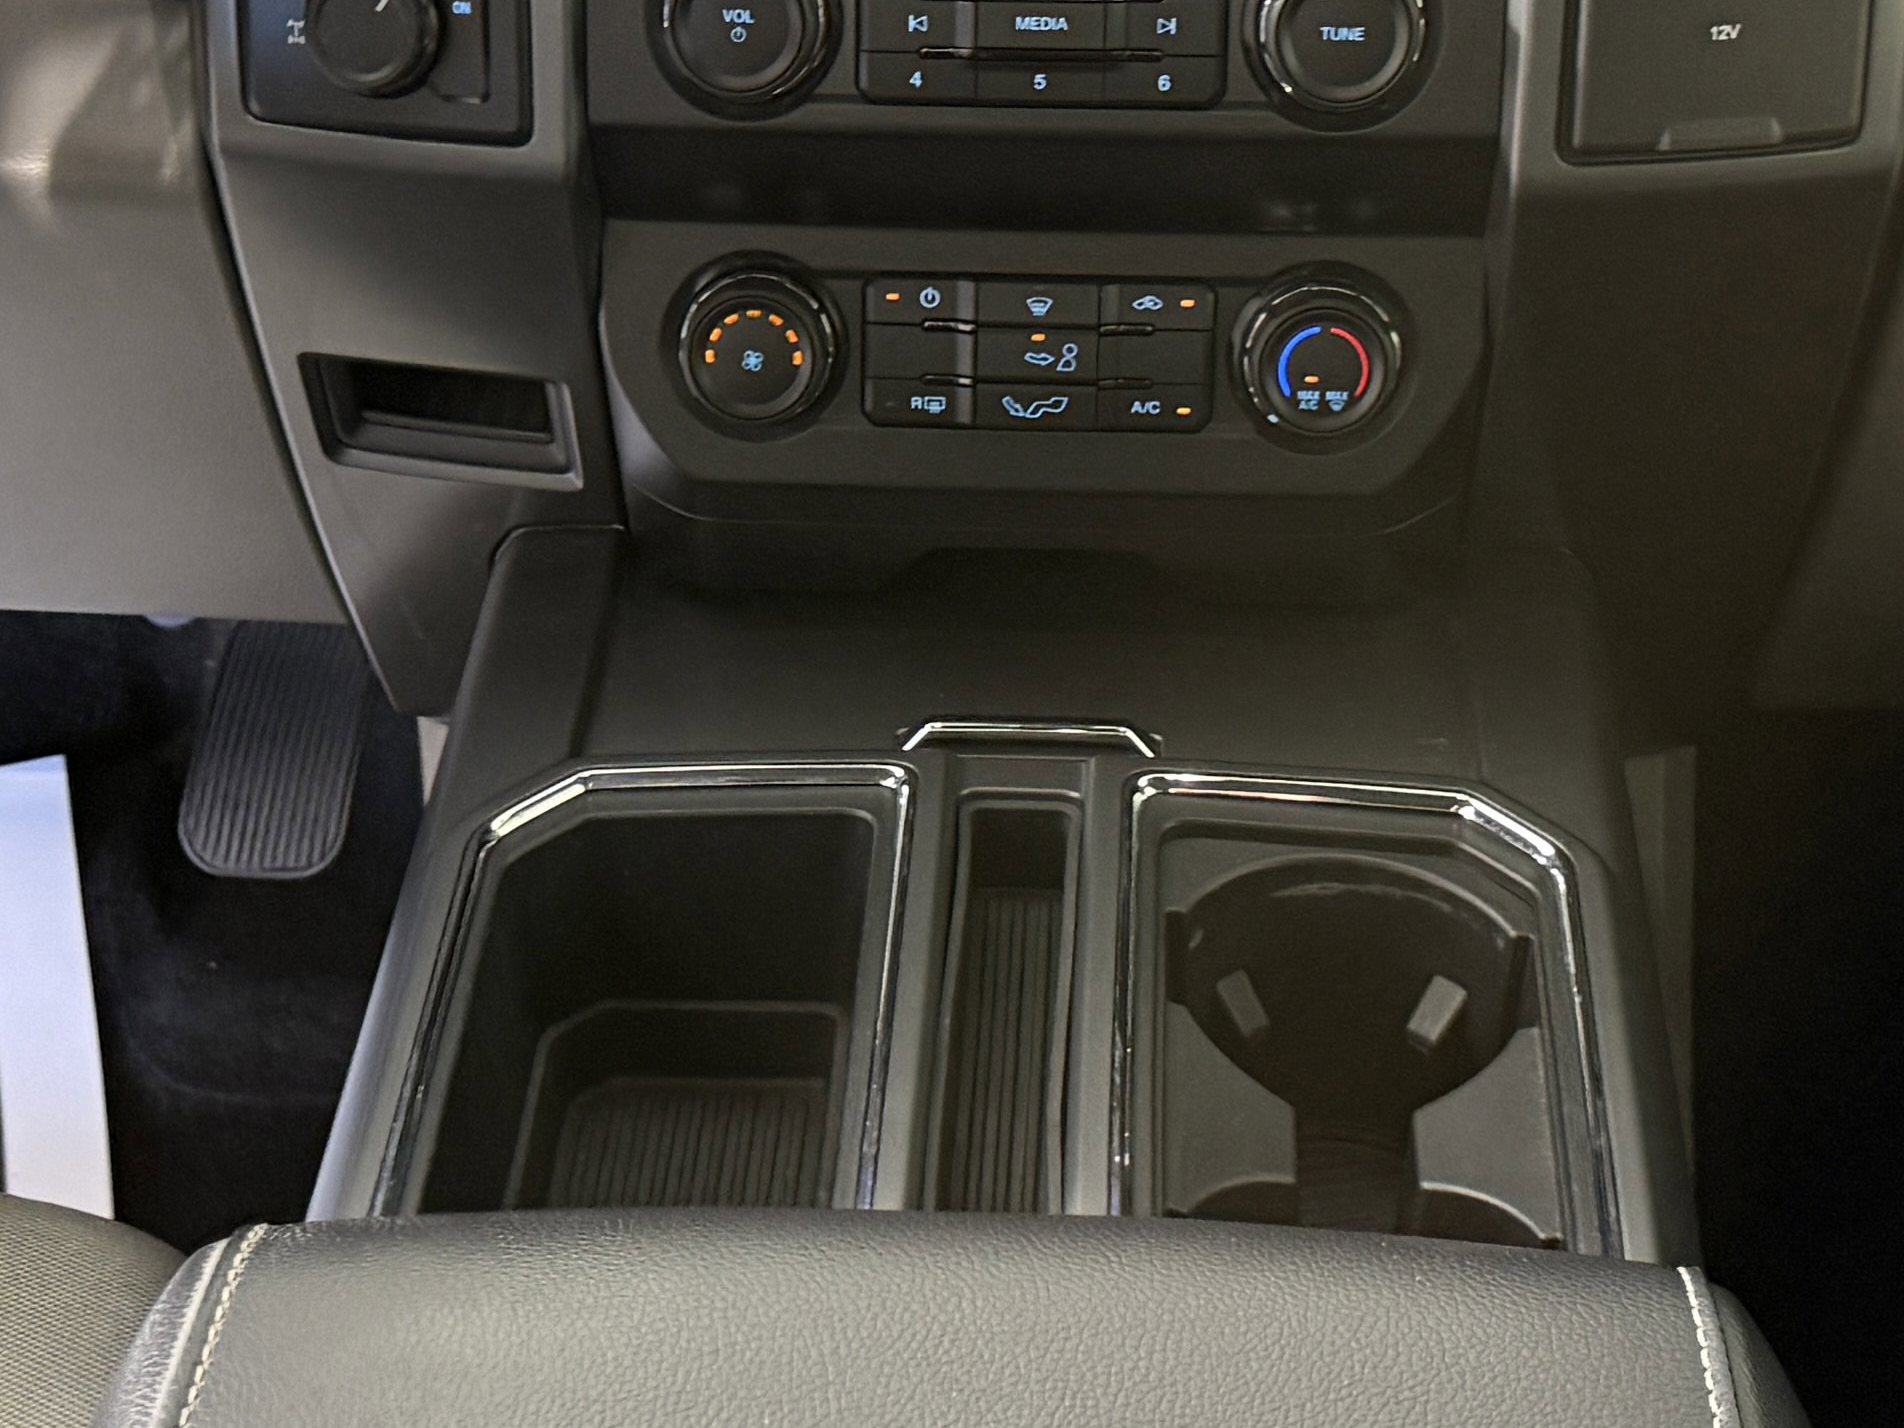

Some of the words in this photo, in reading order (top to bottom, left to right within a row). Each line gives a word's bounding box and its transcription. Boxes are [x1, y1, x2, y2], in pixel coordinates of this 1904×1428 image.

[452, 1, 472, 14] ON
[722, 8, 756, 24] VOL
[1015, 16, 1068, 31] MEDIA
[1319, 26, 1366, 41] TUNE
[1710, 24, 1741, 41] 12V
[909, 71, 922, 88] 4
[1034, 74, 1047, 90] 5
[1158, 75, 1171, 91] 6
[1131, 400, 1160, 415] A/C
